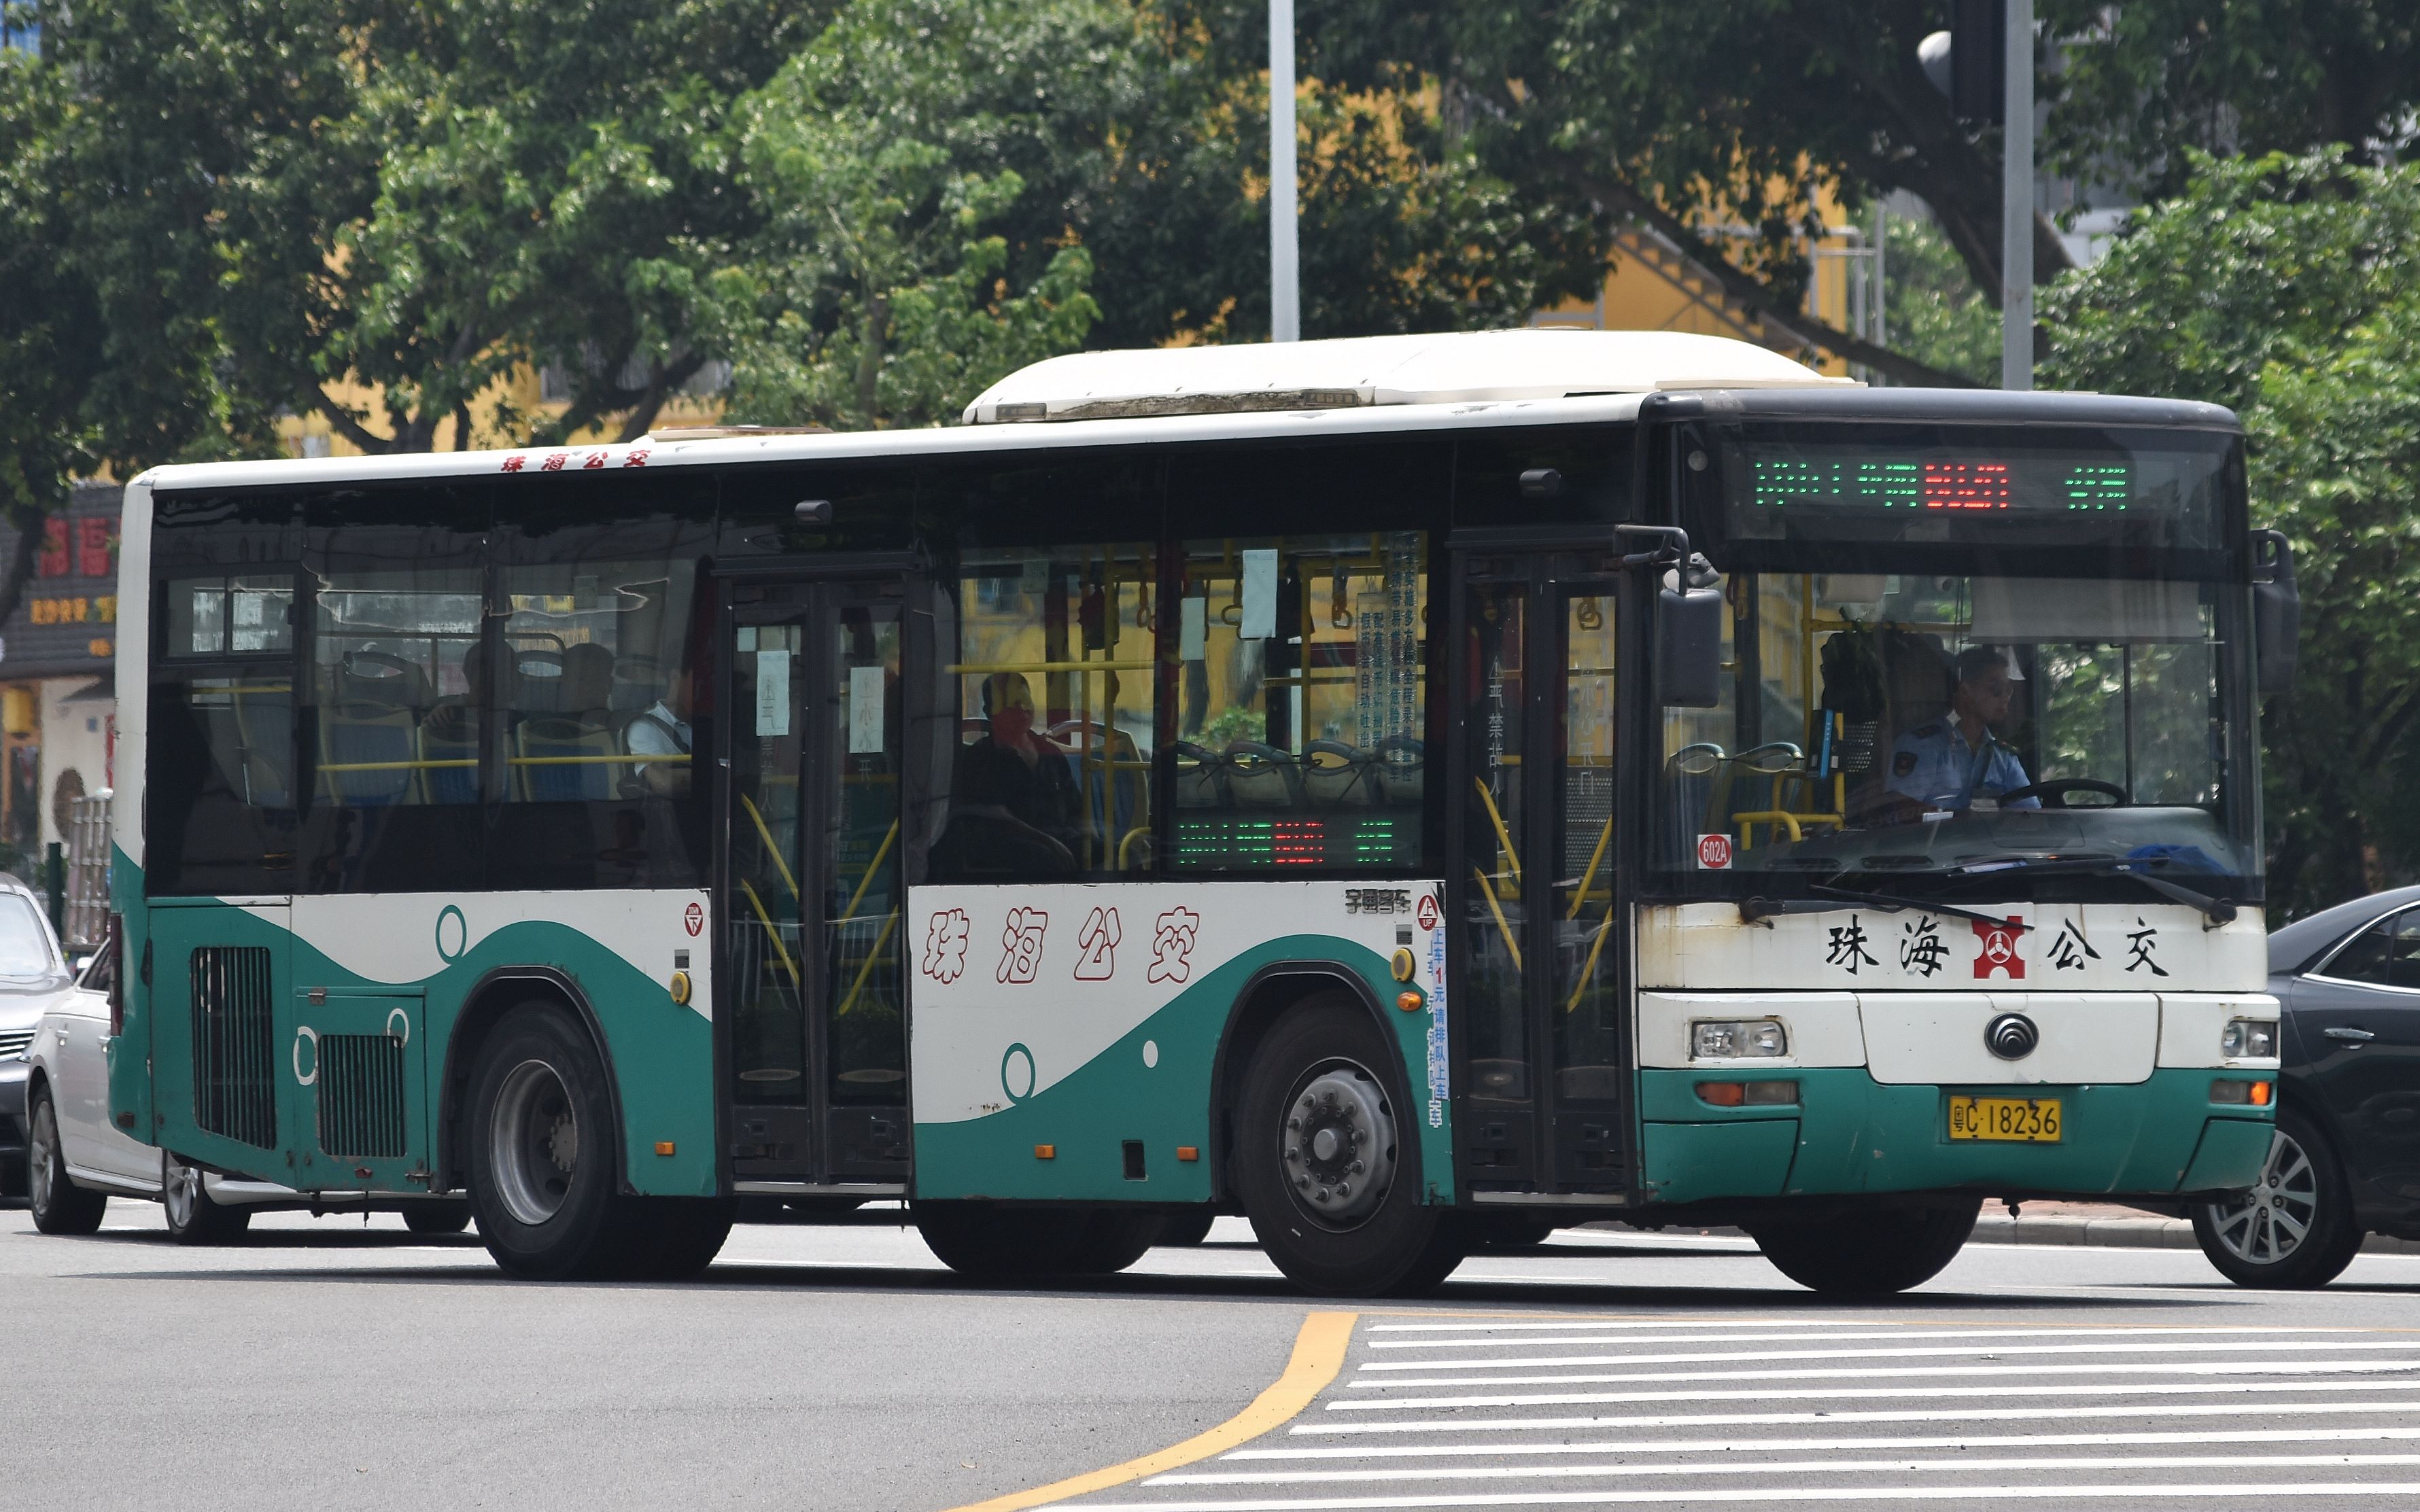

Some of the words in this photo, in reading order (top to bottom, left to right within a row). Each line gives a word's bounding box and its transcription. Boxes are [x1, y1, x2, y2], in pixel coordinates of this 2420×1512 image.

[500, 450, 652, 472] 珠海公交
[1703, 841, 1727, 863] 602A
[1423, 900, 1433, 917] 上
[689, 917, 698, 932] 下
[1423, 919, 1433, 927] UP
[922, 906, 1201, 985] 珠海公交
[1826, 913, 1950, 978] 珠海
[2047, 917, 2170, 978] 公交
